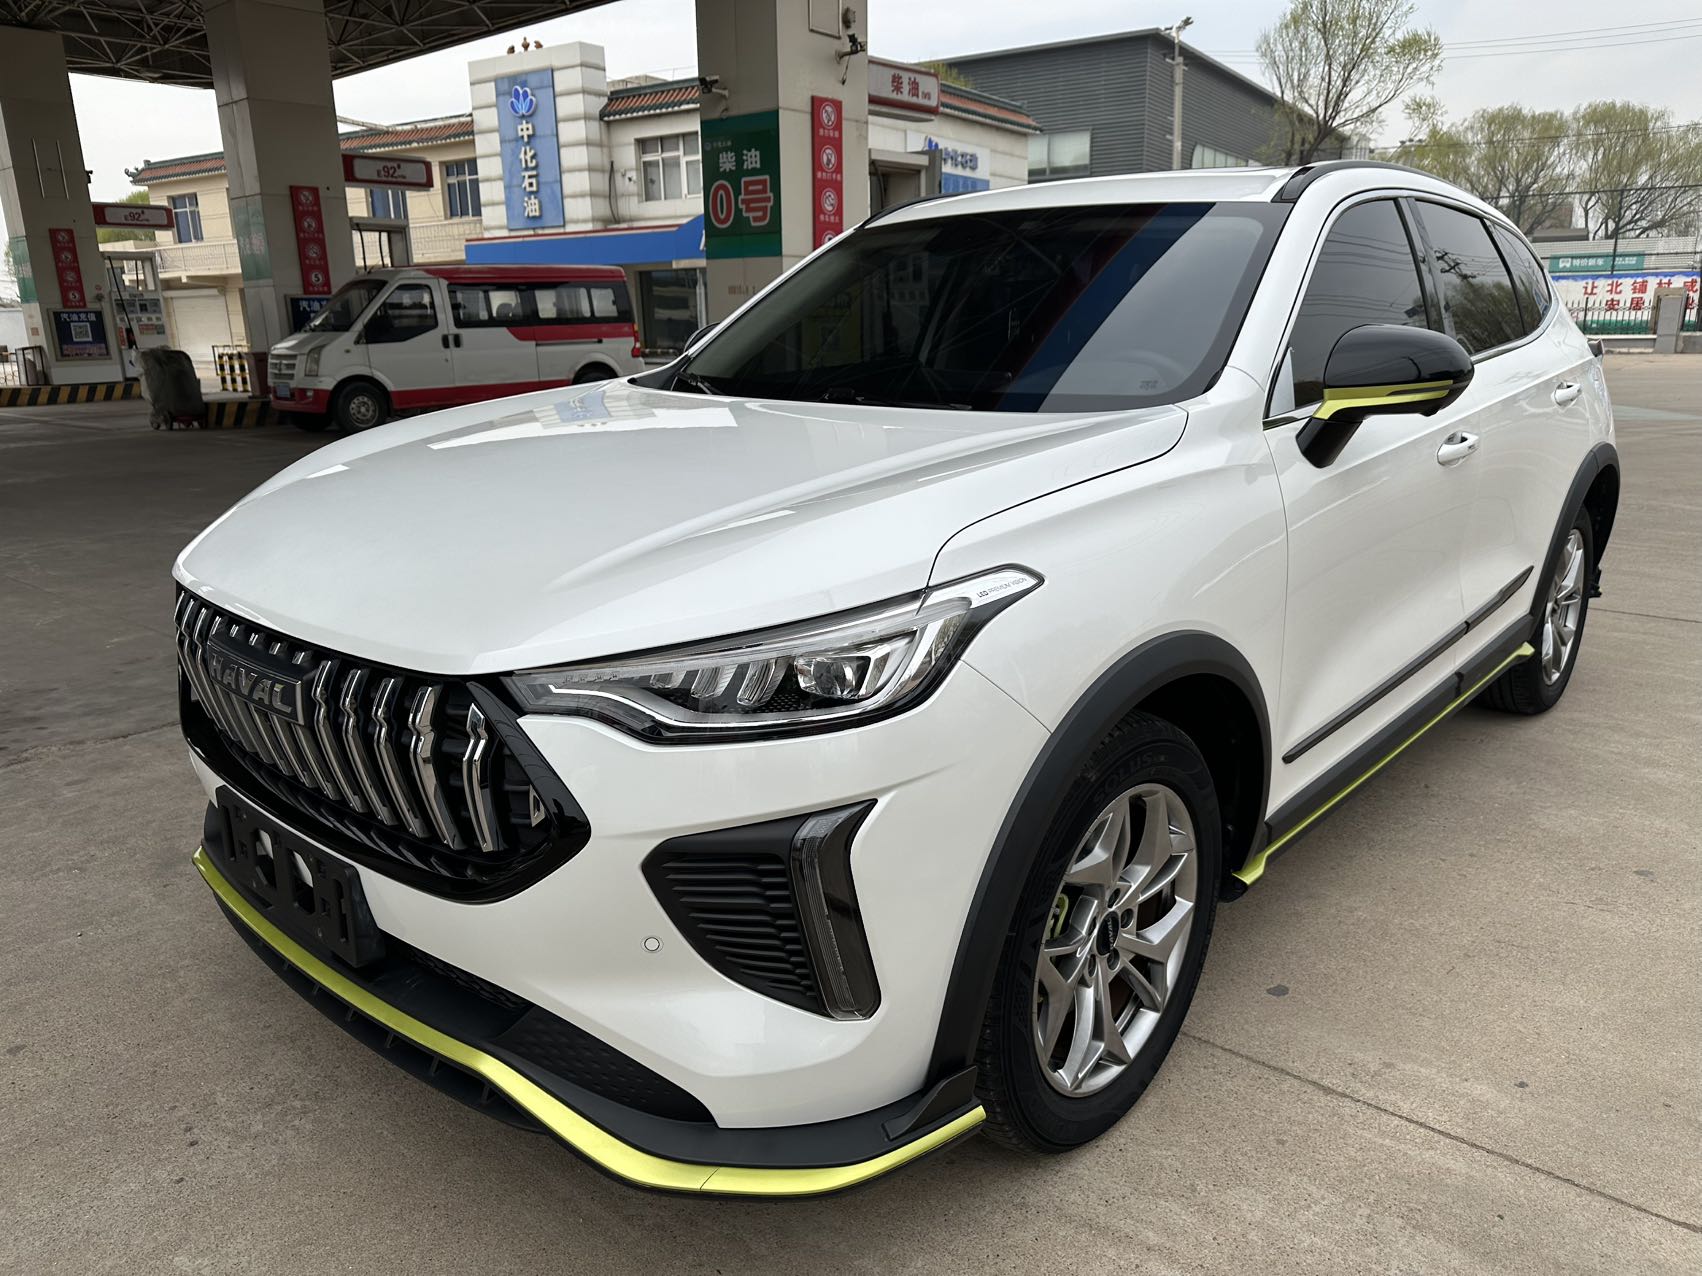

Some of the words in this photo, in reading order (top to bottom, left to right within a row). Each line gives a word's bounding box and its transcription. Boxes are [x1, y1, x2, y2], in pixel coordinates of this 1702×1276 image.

[891, 72, 920, 99] 柴油
[518, 120, 540, 217] 中化石油
[719, 148, 761, 172] 柴油
[709, 174, 773, 228] 0号
[976, 590, 989, 598] LED
[209, 653, 293, 714] HAVAL
